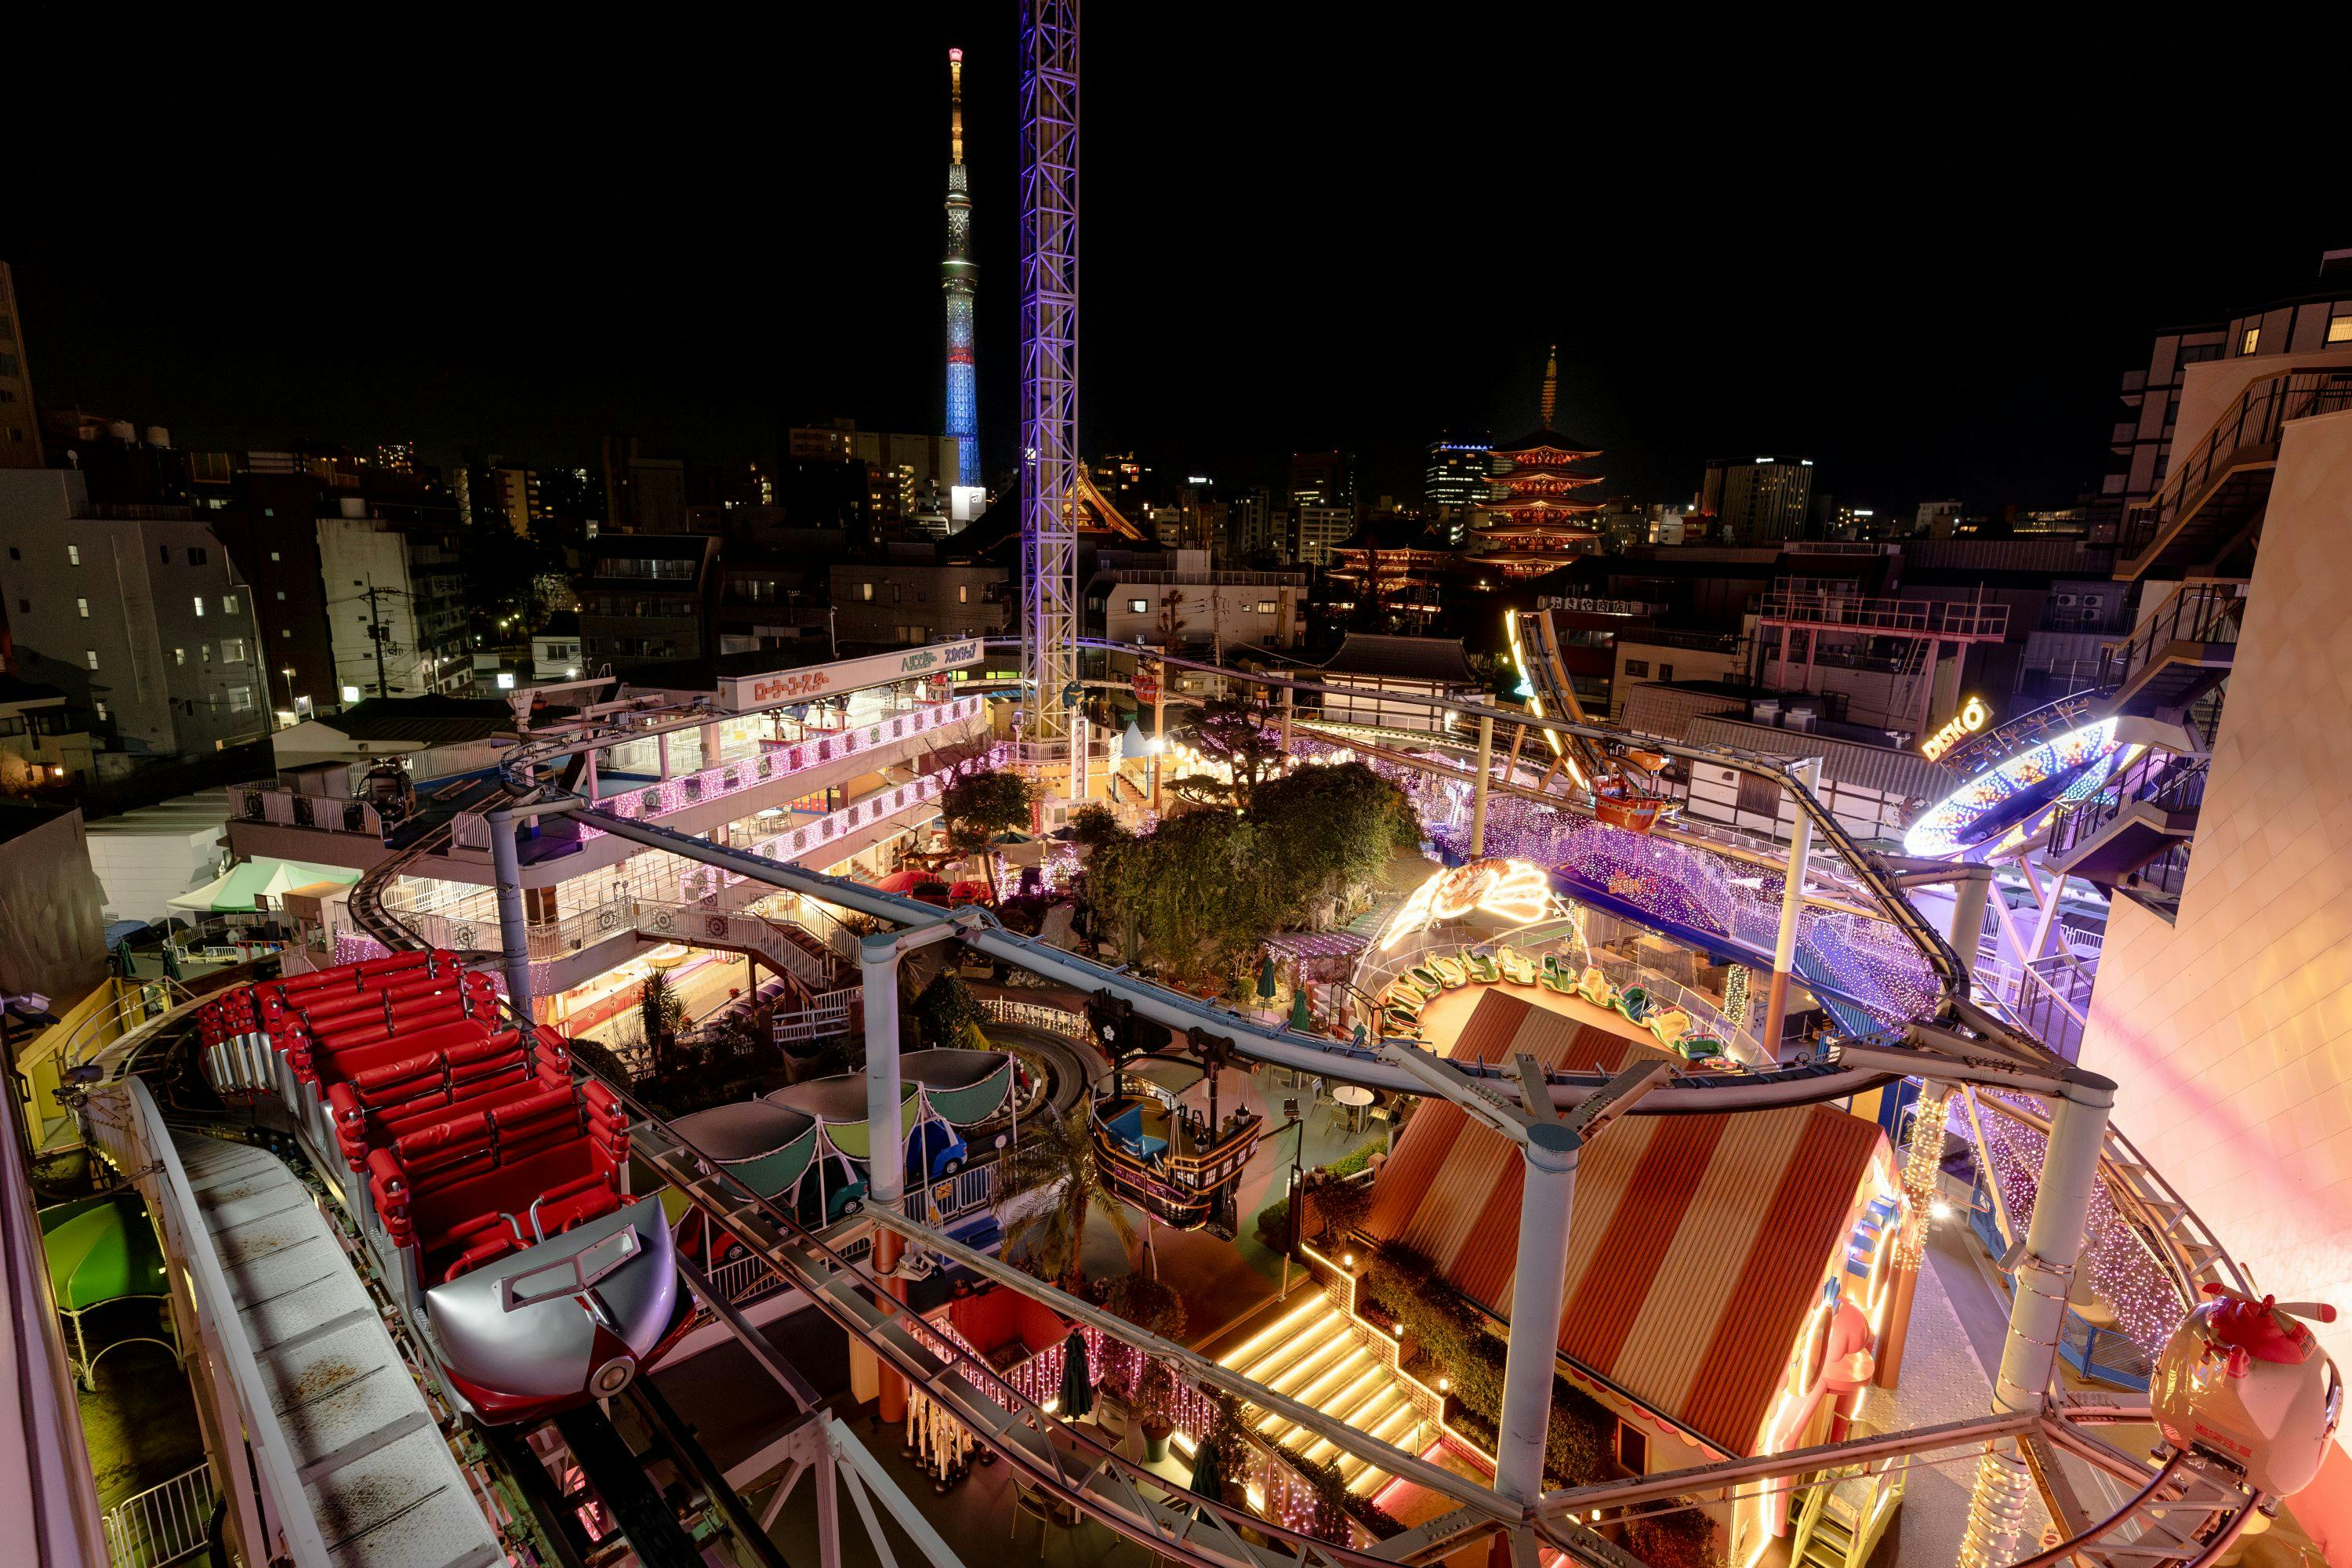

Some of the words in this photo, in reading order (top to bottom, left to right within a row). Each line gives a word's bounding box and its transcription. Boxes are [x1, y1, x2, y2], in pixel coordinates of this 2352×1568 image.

[755, 672, 829, 701] ローラーコースター
